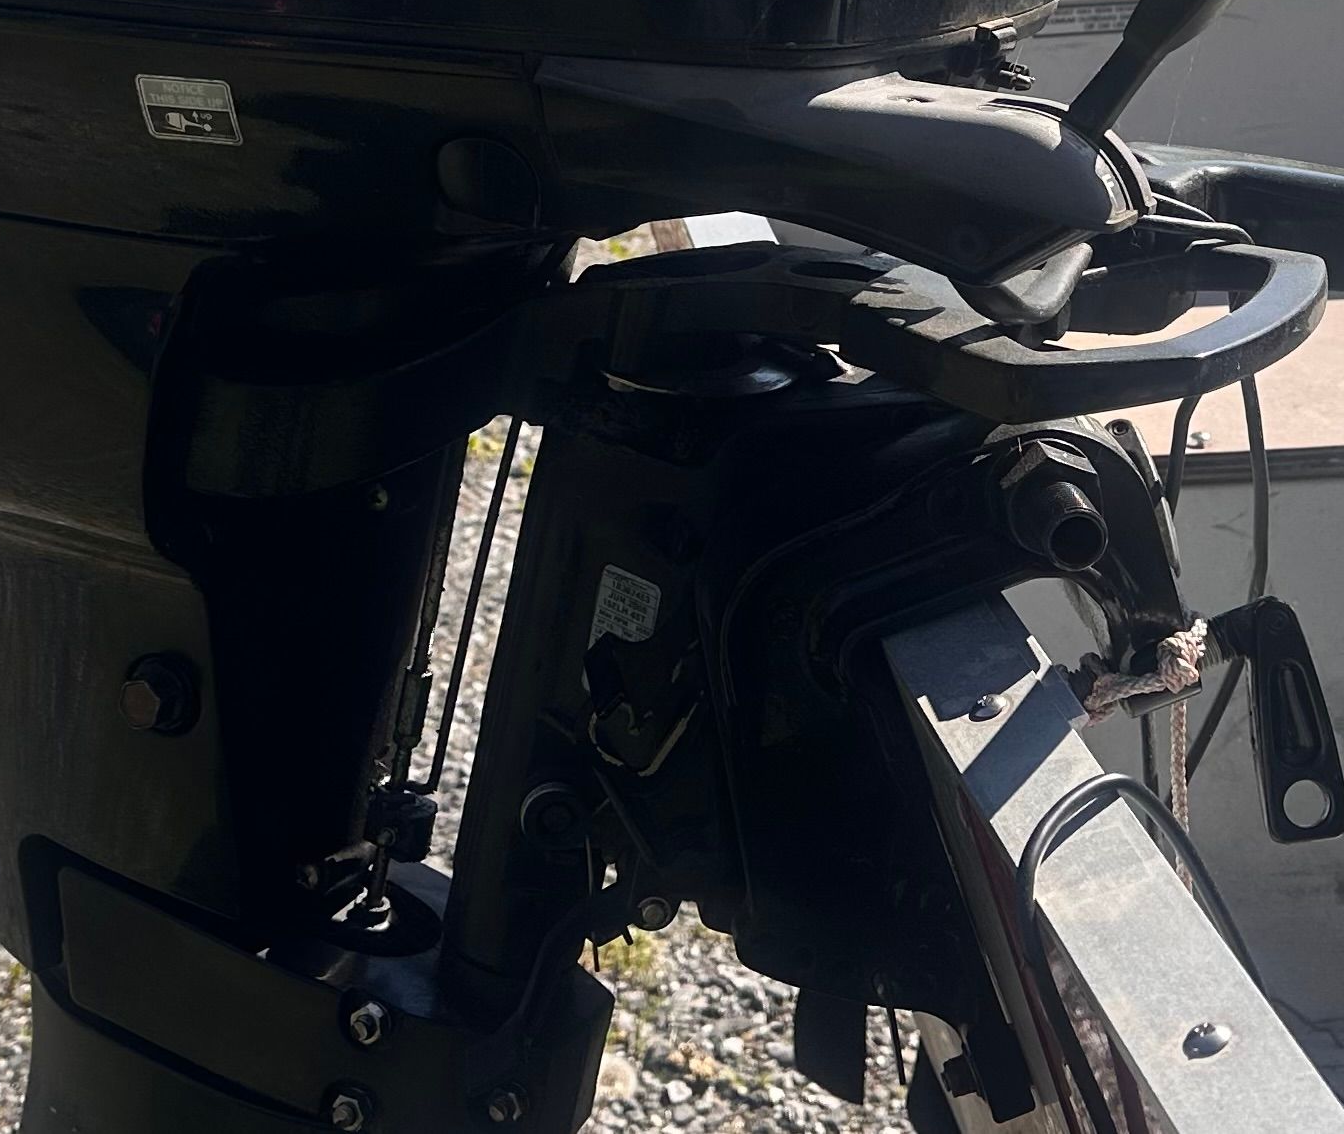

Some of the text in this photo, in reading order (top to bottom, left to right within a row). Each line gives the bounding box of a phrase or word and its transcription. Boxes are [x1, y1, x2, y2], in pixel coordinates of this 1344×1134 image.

[161, 82, 206, 95] NOTICE
[149, 93, 225, 108] THIS SIDE UP
